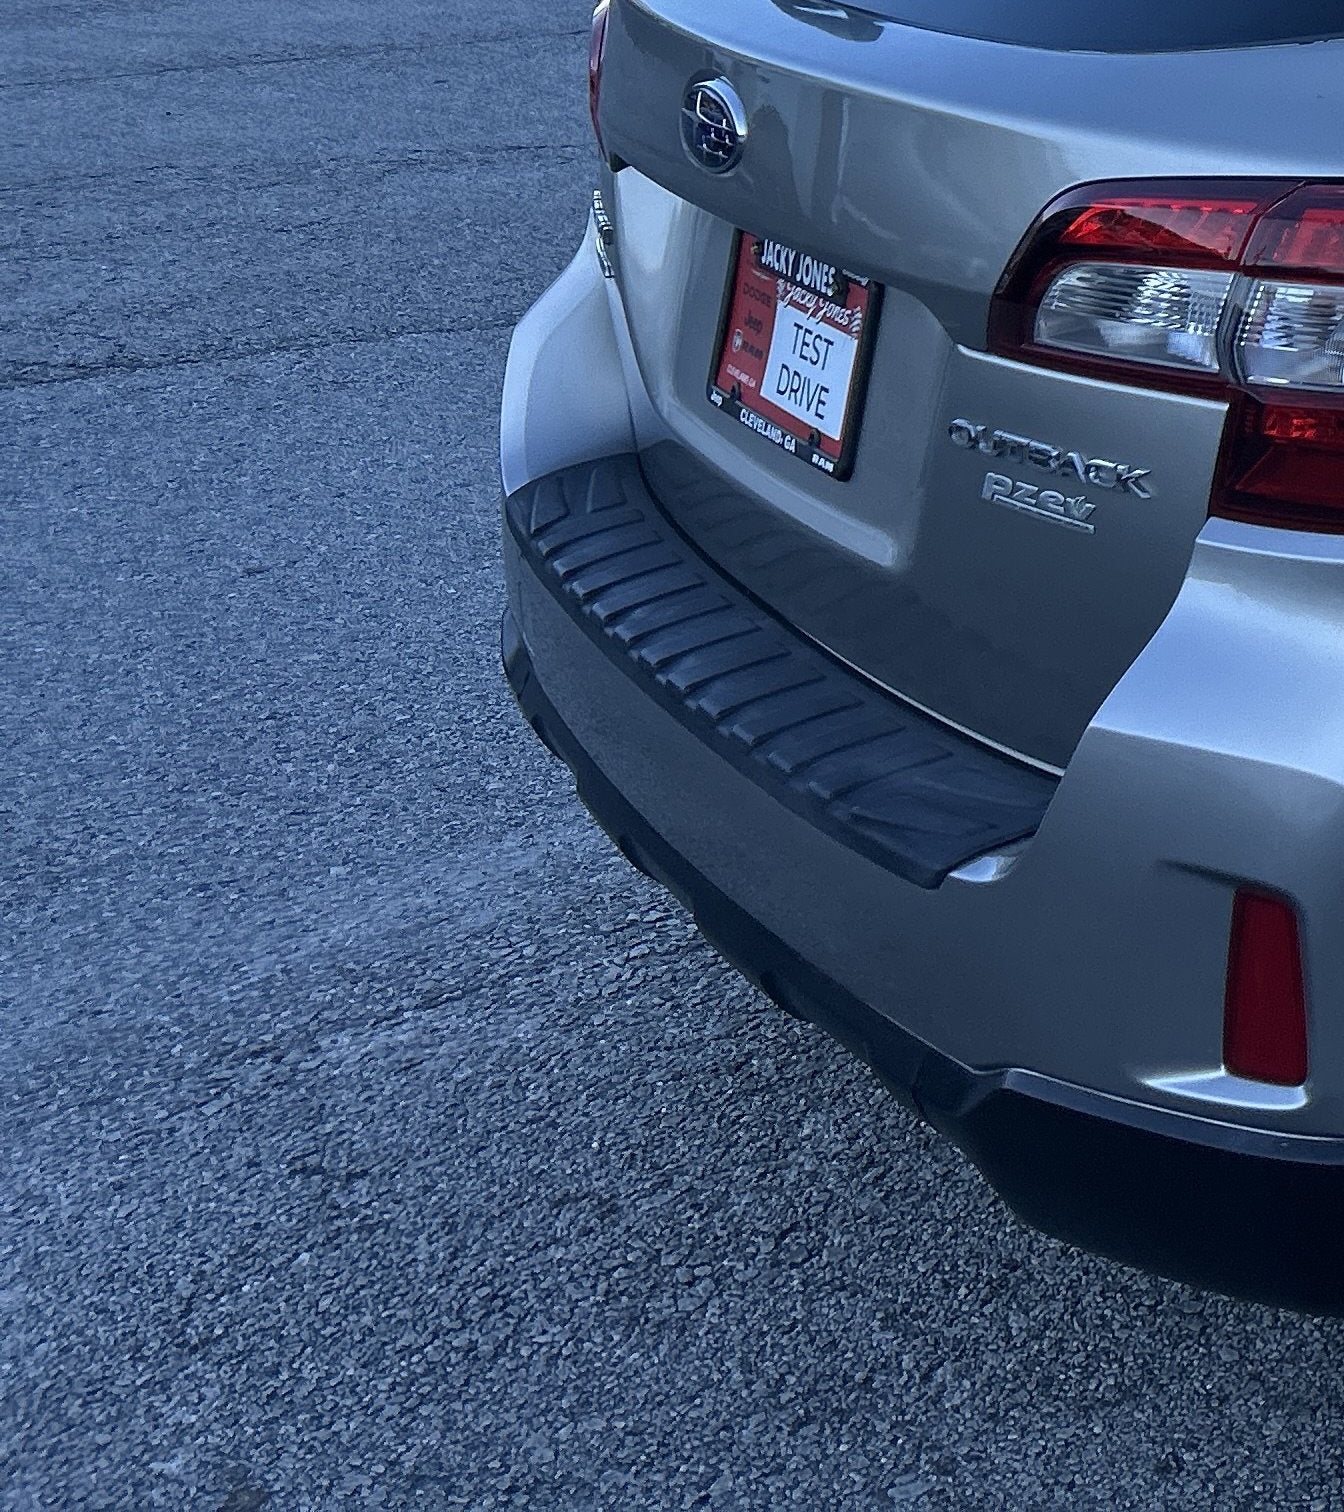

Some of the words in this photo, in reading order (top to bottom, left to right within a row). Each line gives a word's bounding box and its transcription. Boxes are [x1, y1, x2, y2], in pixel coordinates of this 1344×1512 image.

[761, 239, 797, 277] JACKY
[796, 253, 837, 297] JONES
[793, 322, 834, 371] TEST
[776, 363, 830, 420] DRIVE
[783, 434, 797, 453] GA
